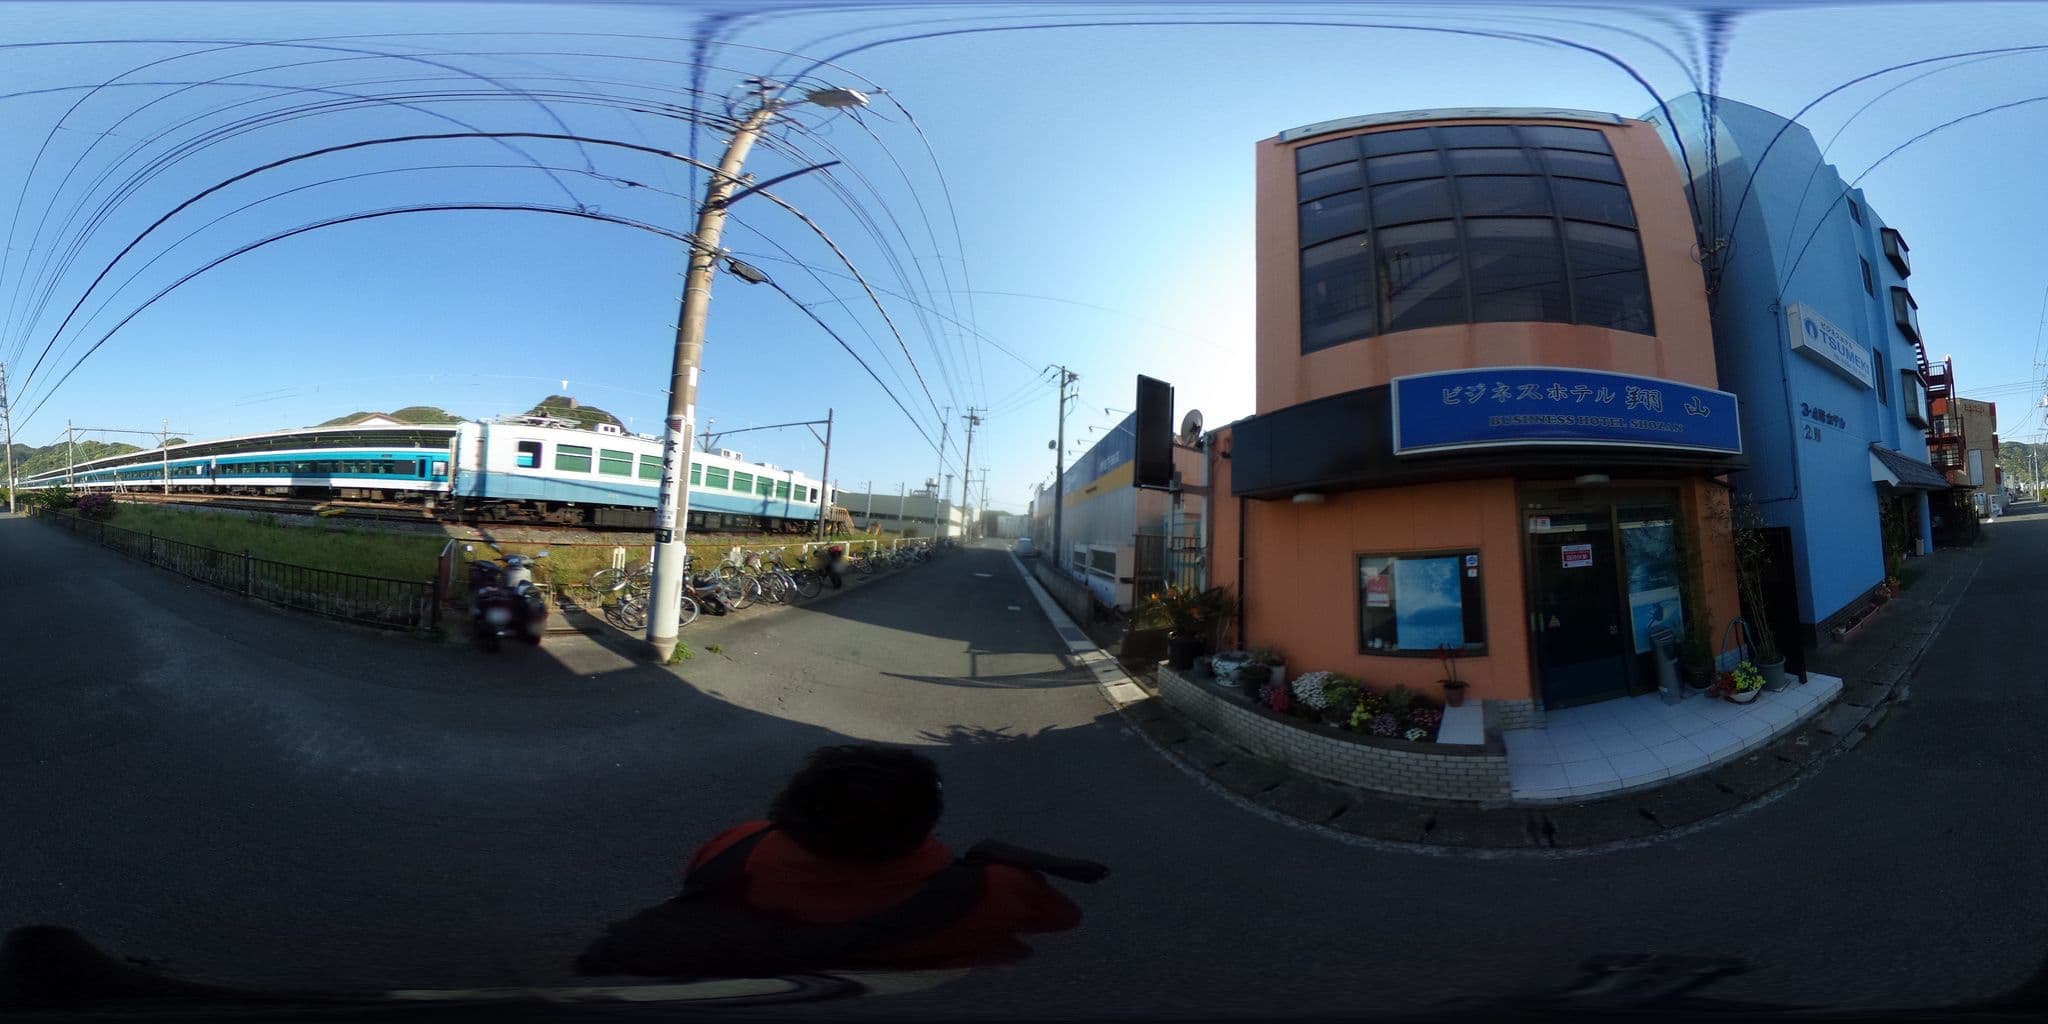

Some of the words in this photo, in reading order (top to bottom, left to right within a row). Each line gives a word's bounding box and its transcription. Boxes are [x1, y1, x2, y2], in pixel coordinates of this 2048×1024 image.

[1442, 381, 1616, 405] ビジネスホテル
[1580, 415, 1625, 429] HOTEL
[1631, 418, 1686, 433] SHOZAN
